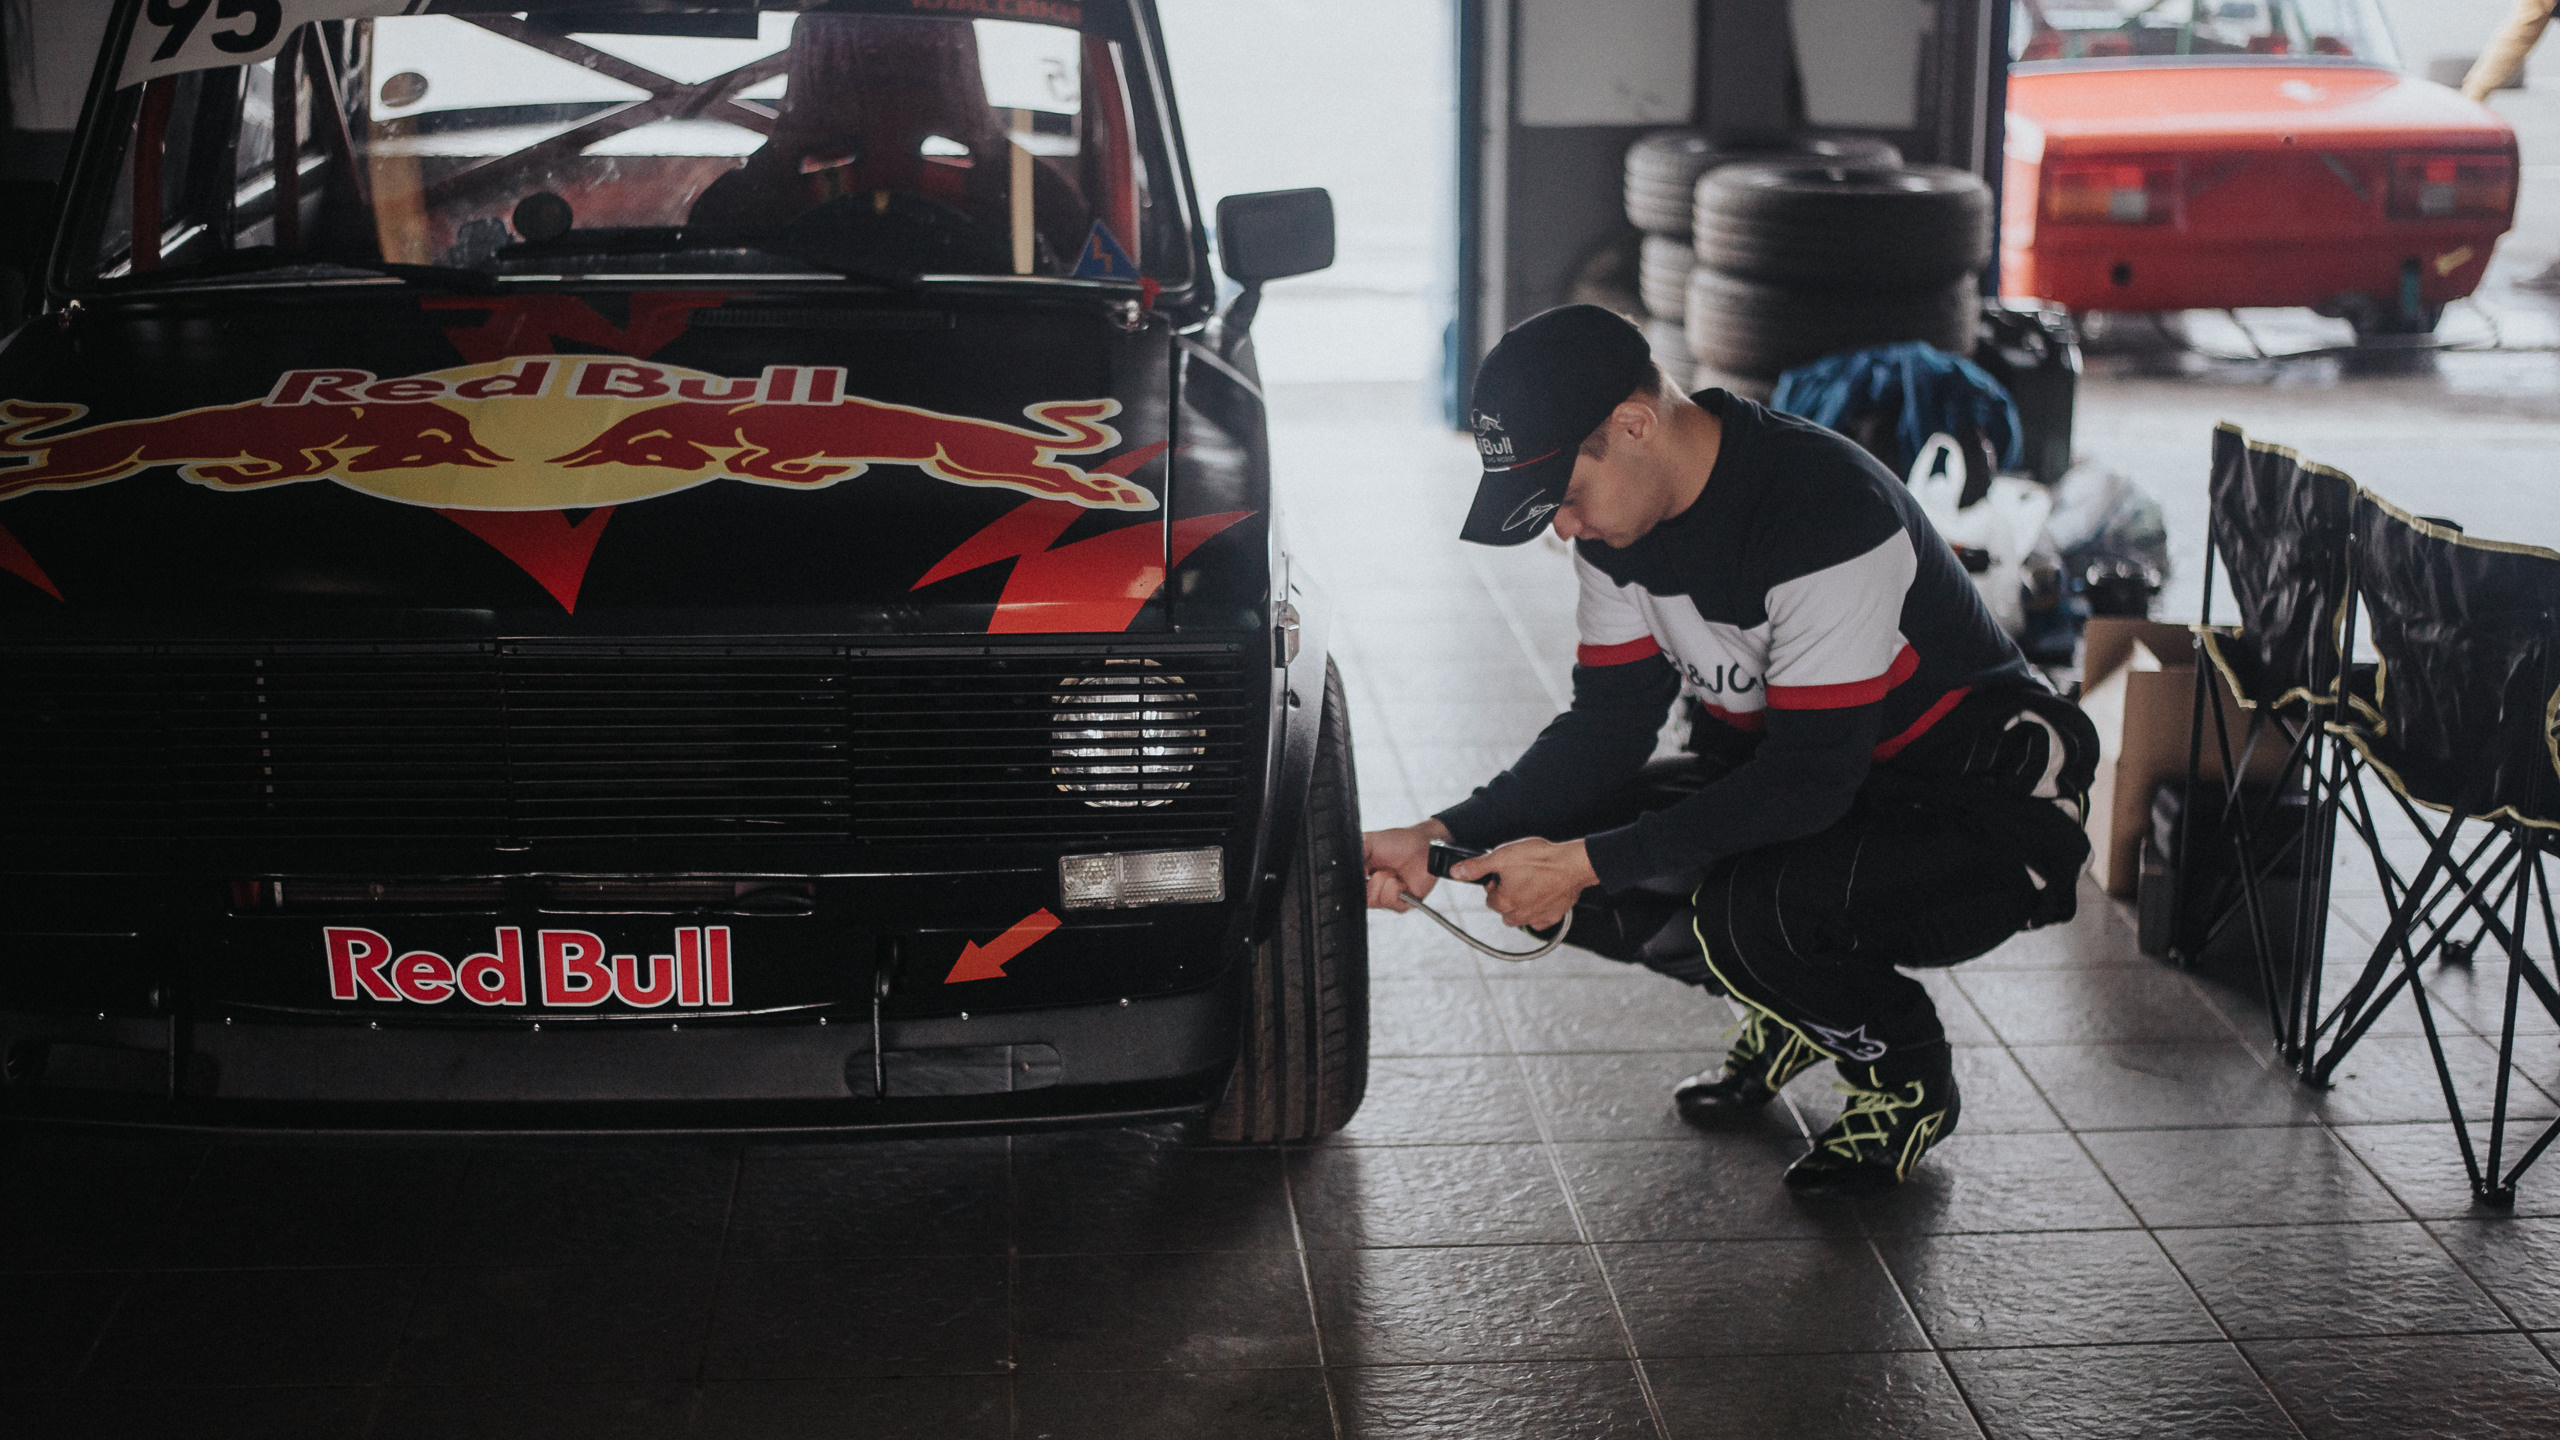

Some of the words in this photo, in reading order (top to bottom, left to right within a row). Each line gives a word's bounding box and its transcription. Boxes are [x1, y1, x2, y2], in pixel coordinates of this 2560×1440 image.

[147, 0, 282, 62] 95
[264, 359, 553, 406] Red
[563, 360, 847, 406] Bull
[1482, 436, 1513, 455] Bull
[323, 926, 527, 1005] Red
[538, 926, 732, 1006] Bull
